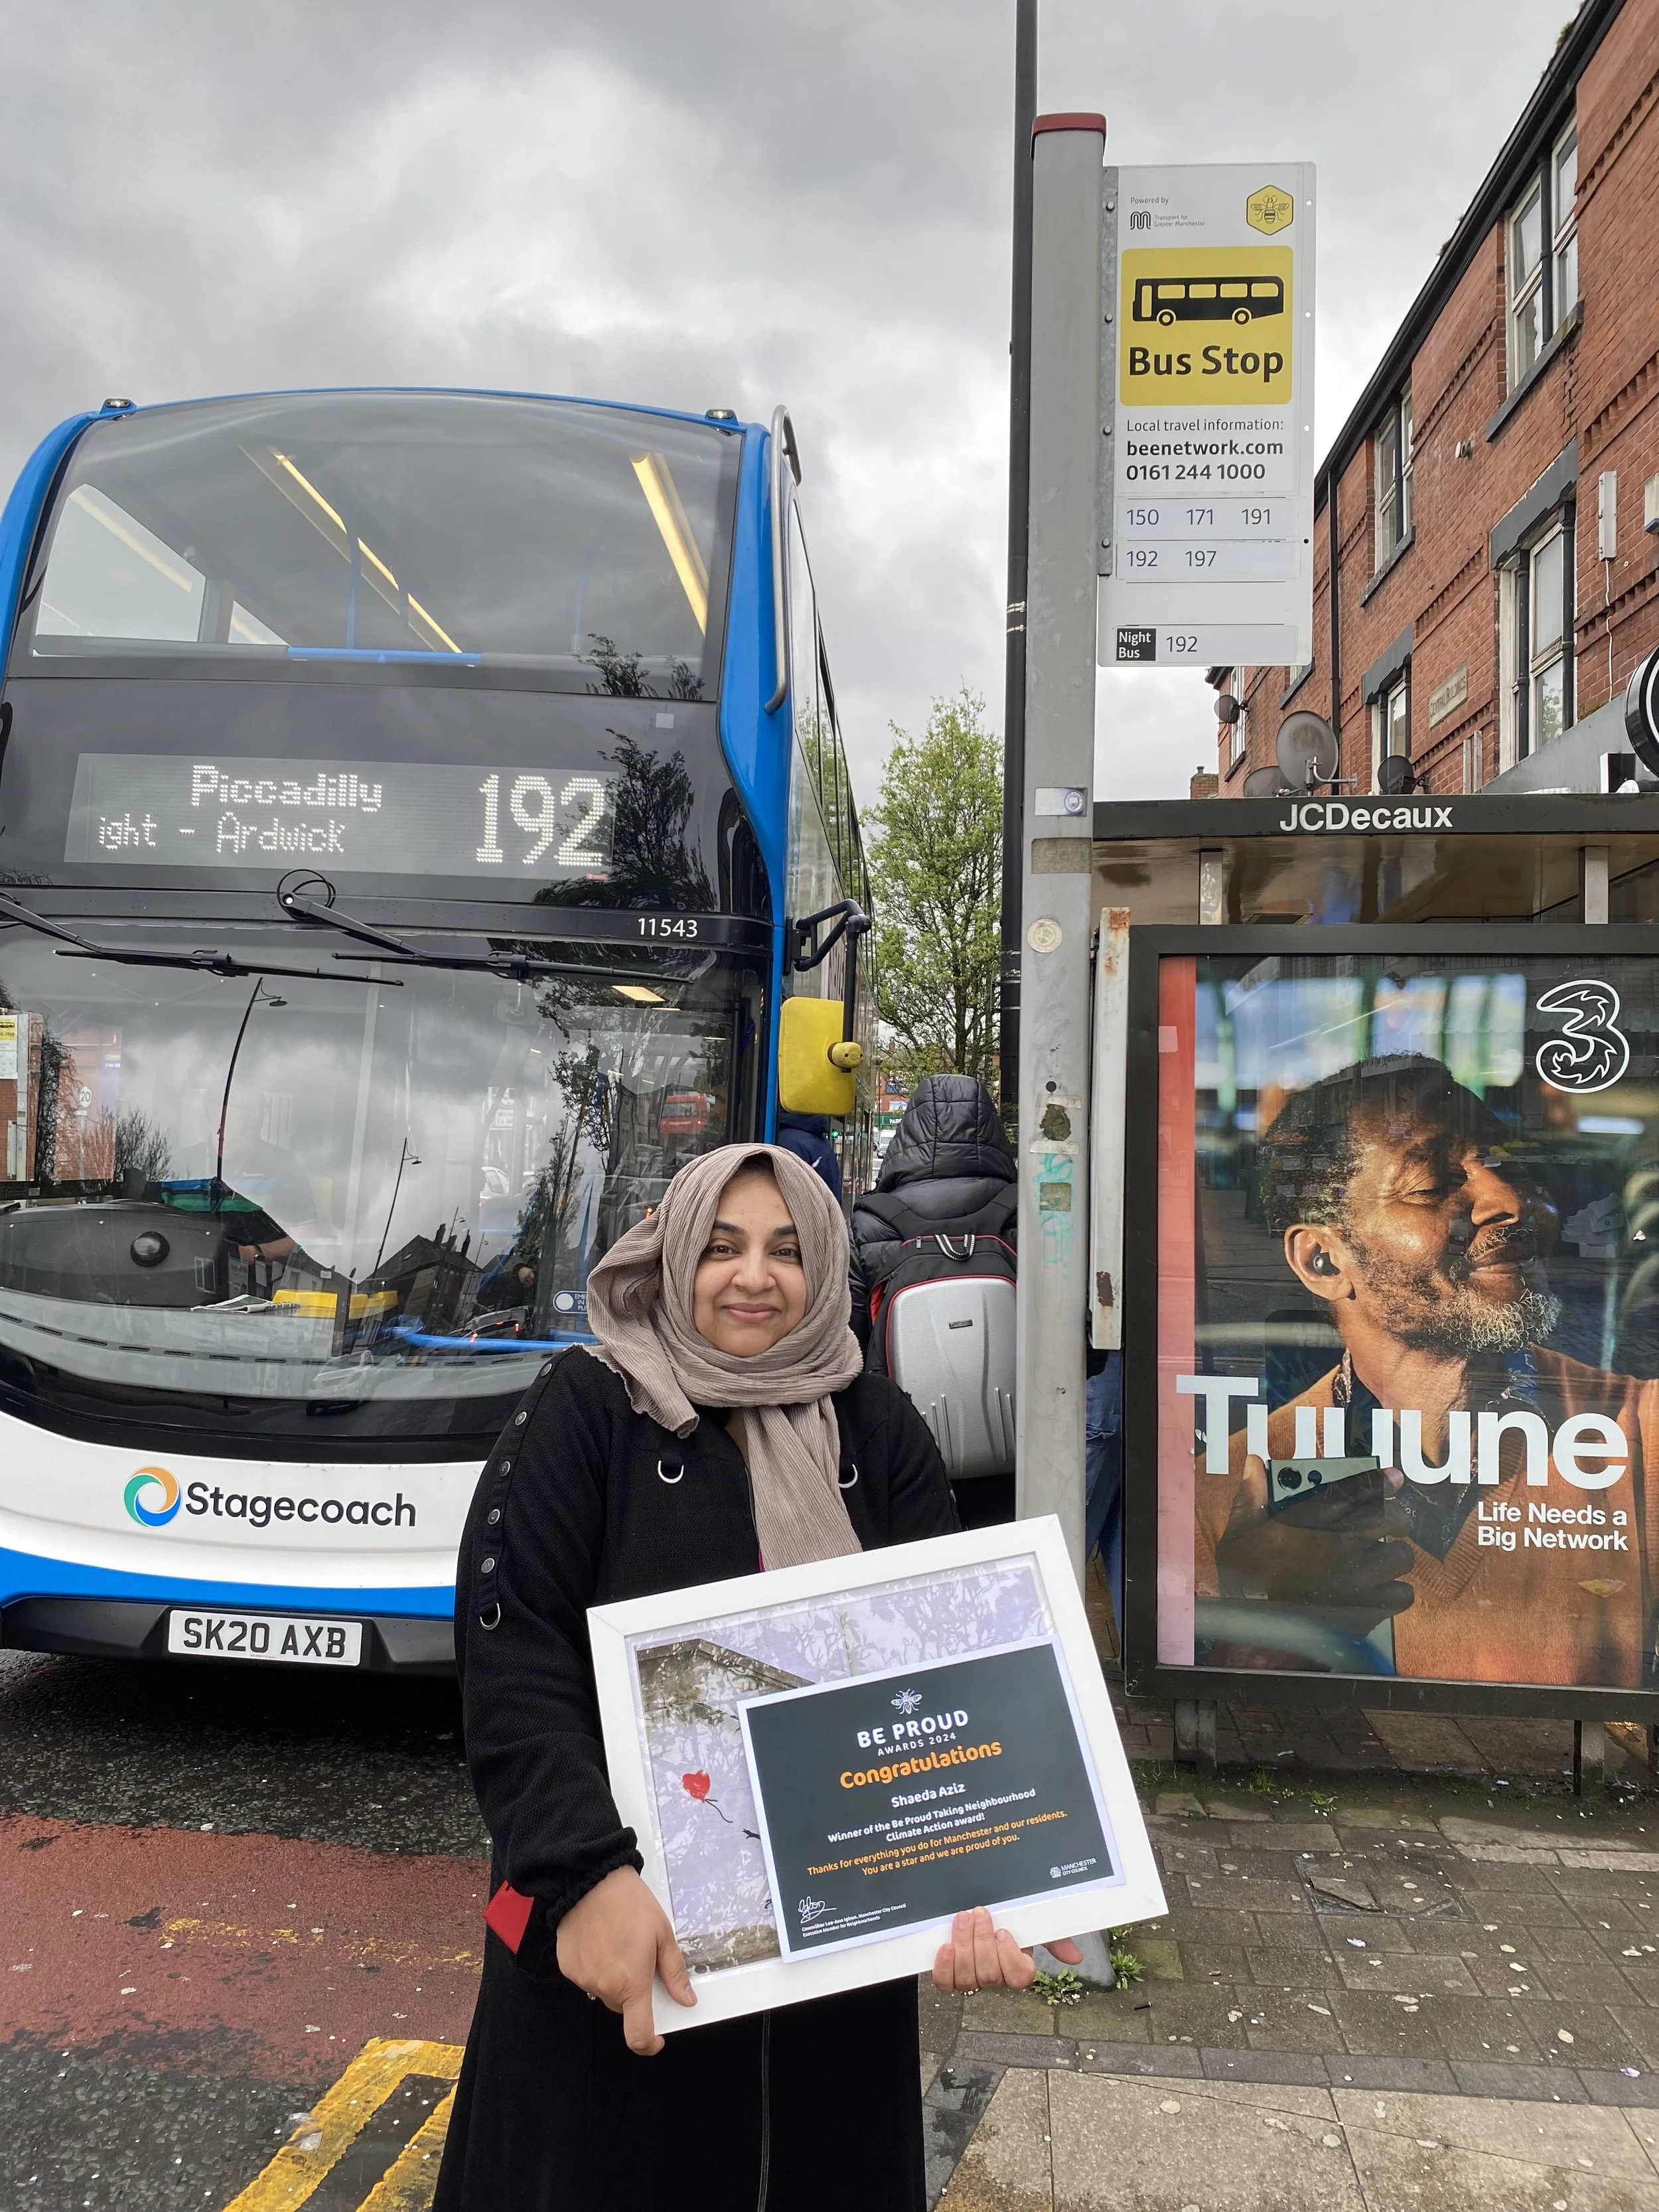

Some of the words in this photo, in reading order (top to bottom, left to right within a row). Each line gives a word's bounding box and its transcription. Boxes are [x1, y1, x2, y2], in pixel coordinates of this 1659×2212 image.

[1129, 346, 1191, 376] Bus
[1202, 346, 1283, 383] Stop
[1127, 420, 1159, 431] Local
[1164, 419, 1200, 431] travel
[1204, 418, 1283, 431] information:
[1127, 439, 1283, 456] beenetwork.com
[1126, 465, 1170, 480] 0161
[1175, 465, 1212, 480] 244
[1217, 464, 1265, 480] 1000
[1127, 509, 1159, 525] 150
[1187, 509, 1214, 525] 171
[1242, 508, 1271, 524] 191
[1126, 551, 1158, 567] 192
[1185, 551, 1217, 567] 197
[1119, 632, 1151, 646] Night
[1166, 636, 1198, 652] 192
[1119, 647, 1140, 658] Bus
[192, 765, 382, 812] Piccadilly
[476, 773, 605, 867] 192
[1279, 802, 1454, 832] JCDecaux
[98, 813, 157, 849] ight
[216, 811, 346, 854] Ardwick
[637, 918, 698, 938] 11543
[81, 1090, 91, 1102] 20
[186, 1481, 417, 1528] Stagecoach
[1478, 1501, 1522, 1522] Life
[1528, 1503, 1606, 1526] Needs
[1612, 1509, 1628, 1526] a
[1478, 1526, 1516, 1552] Big
[1524, 1527, 1629, 1551] Network
[184, 1617, 271, 1653] SK20
[280, 1624, 346, 1659] AXB
[857, 1727, 885, 1747] BE
[892, 1710, 968, 1739] PROUD
[877, 1739, 924, 1756] AWARDS
[928, 1732, 956, 1744] 2024
[840, 1741, 1001, 1788] Congratulations
[891, 1789, 936, 1807] Shaeda
[939, 1783, 966, 1797] Aziz
[828, 1828, 862, 1842] Winner
[863, 1824, 873, 1834] of
[874, 1822, 891, 1832] the
[904, 1811, 932, 1825] Proud
[932, 1806, 964, 1818] Taking
[964, 1788, 1035, 1811] Neighbourhood
[886, 1828, 922, 1841] Climate
[923, 1820, 953, 1833] Action
[954, 1812, 985, 1826] award!
[807, 1863, 838, 1875] Thanks
[853, 1849, 899, 1864] everything
[900, 1845, 916, 1856] you
[944, 1827, 991, 1844] Manchester
[993, 1822, 1009, 1832] and
[1011, 1820, 1024, 1828] our
[1026, 1810, 1067, 1824] residents.
[862, 1866, 878, 1875] You
[901, 1857, 917, 1866] star
[919, 1851, 934, 1862] and
[950, 1846, 964, 1855] are
[965, 1838, 990, 1853] proud
[991, 1836, 1000, 1845] of
[1001, 1834, 1019, 1844] you.
[1060, 1858, 1097, 1871] MANCHESTER
[802, 1929, 822, 1937] Executive
[846, 1915, 880, 1927] Neighbourhoods
[802, 1923, 824, 1931] Councillor
